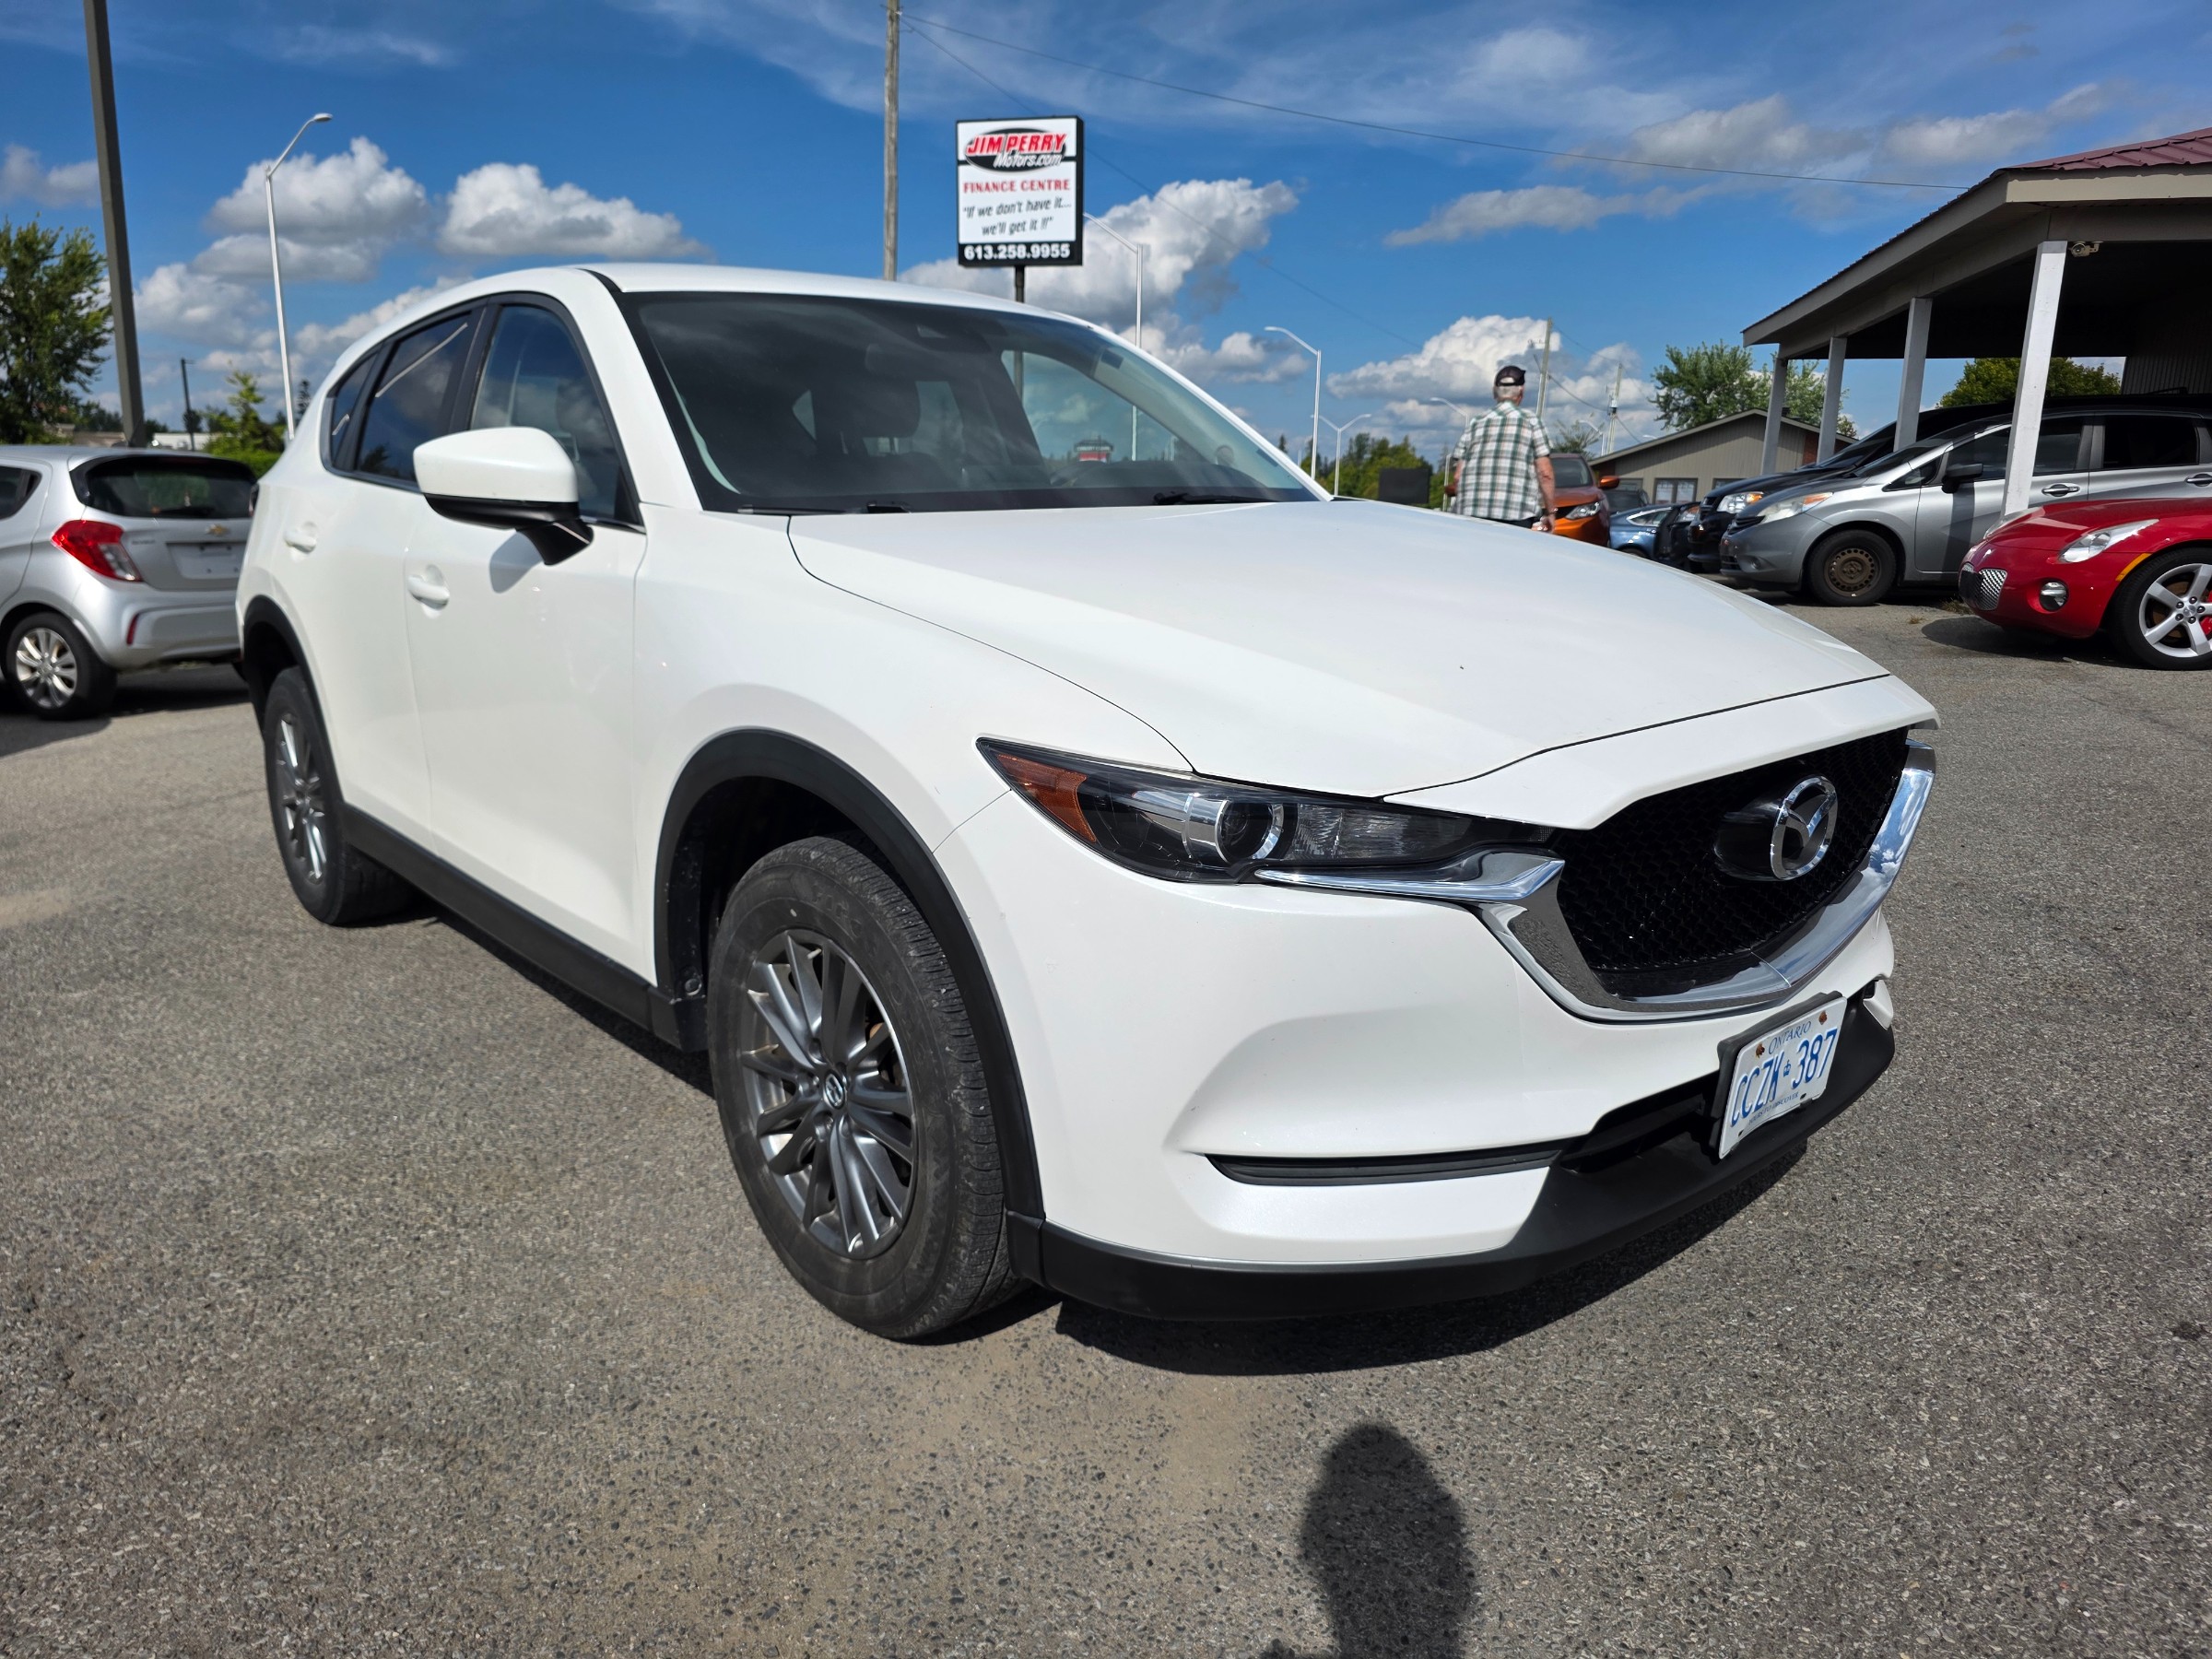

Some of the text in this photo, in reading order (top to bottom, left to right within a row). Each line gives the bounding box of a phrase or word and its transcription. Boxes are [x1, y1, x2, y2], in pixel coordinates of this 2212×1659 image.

[967, 133, 1067, 155] JIM PERRY
[993, 153, 1064, 169] Motors.com
[963, 179, 1070, 194] FINANCE CENTRE
[977, 206, 993, 217] we
[995, 201, 1023, 215] don't
[1026, 198, 1052, 212] have
[982, 221, 1006, 236] we'll
[1009, 221, 1027, 236] get
[1030, 218, 1039, 231] it
[964, 243, 1071, 261] 613.258.9955
[1768, 1020, 1812, 1054] ONTARIO
[1791, 1028, 1838, 1089] 387
